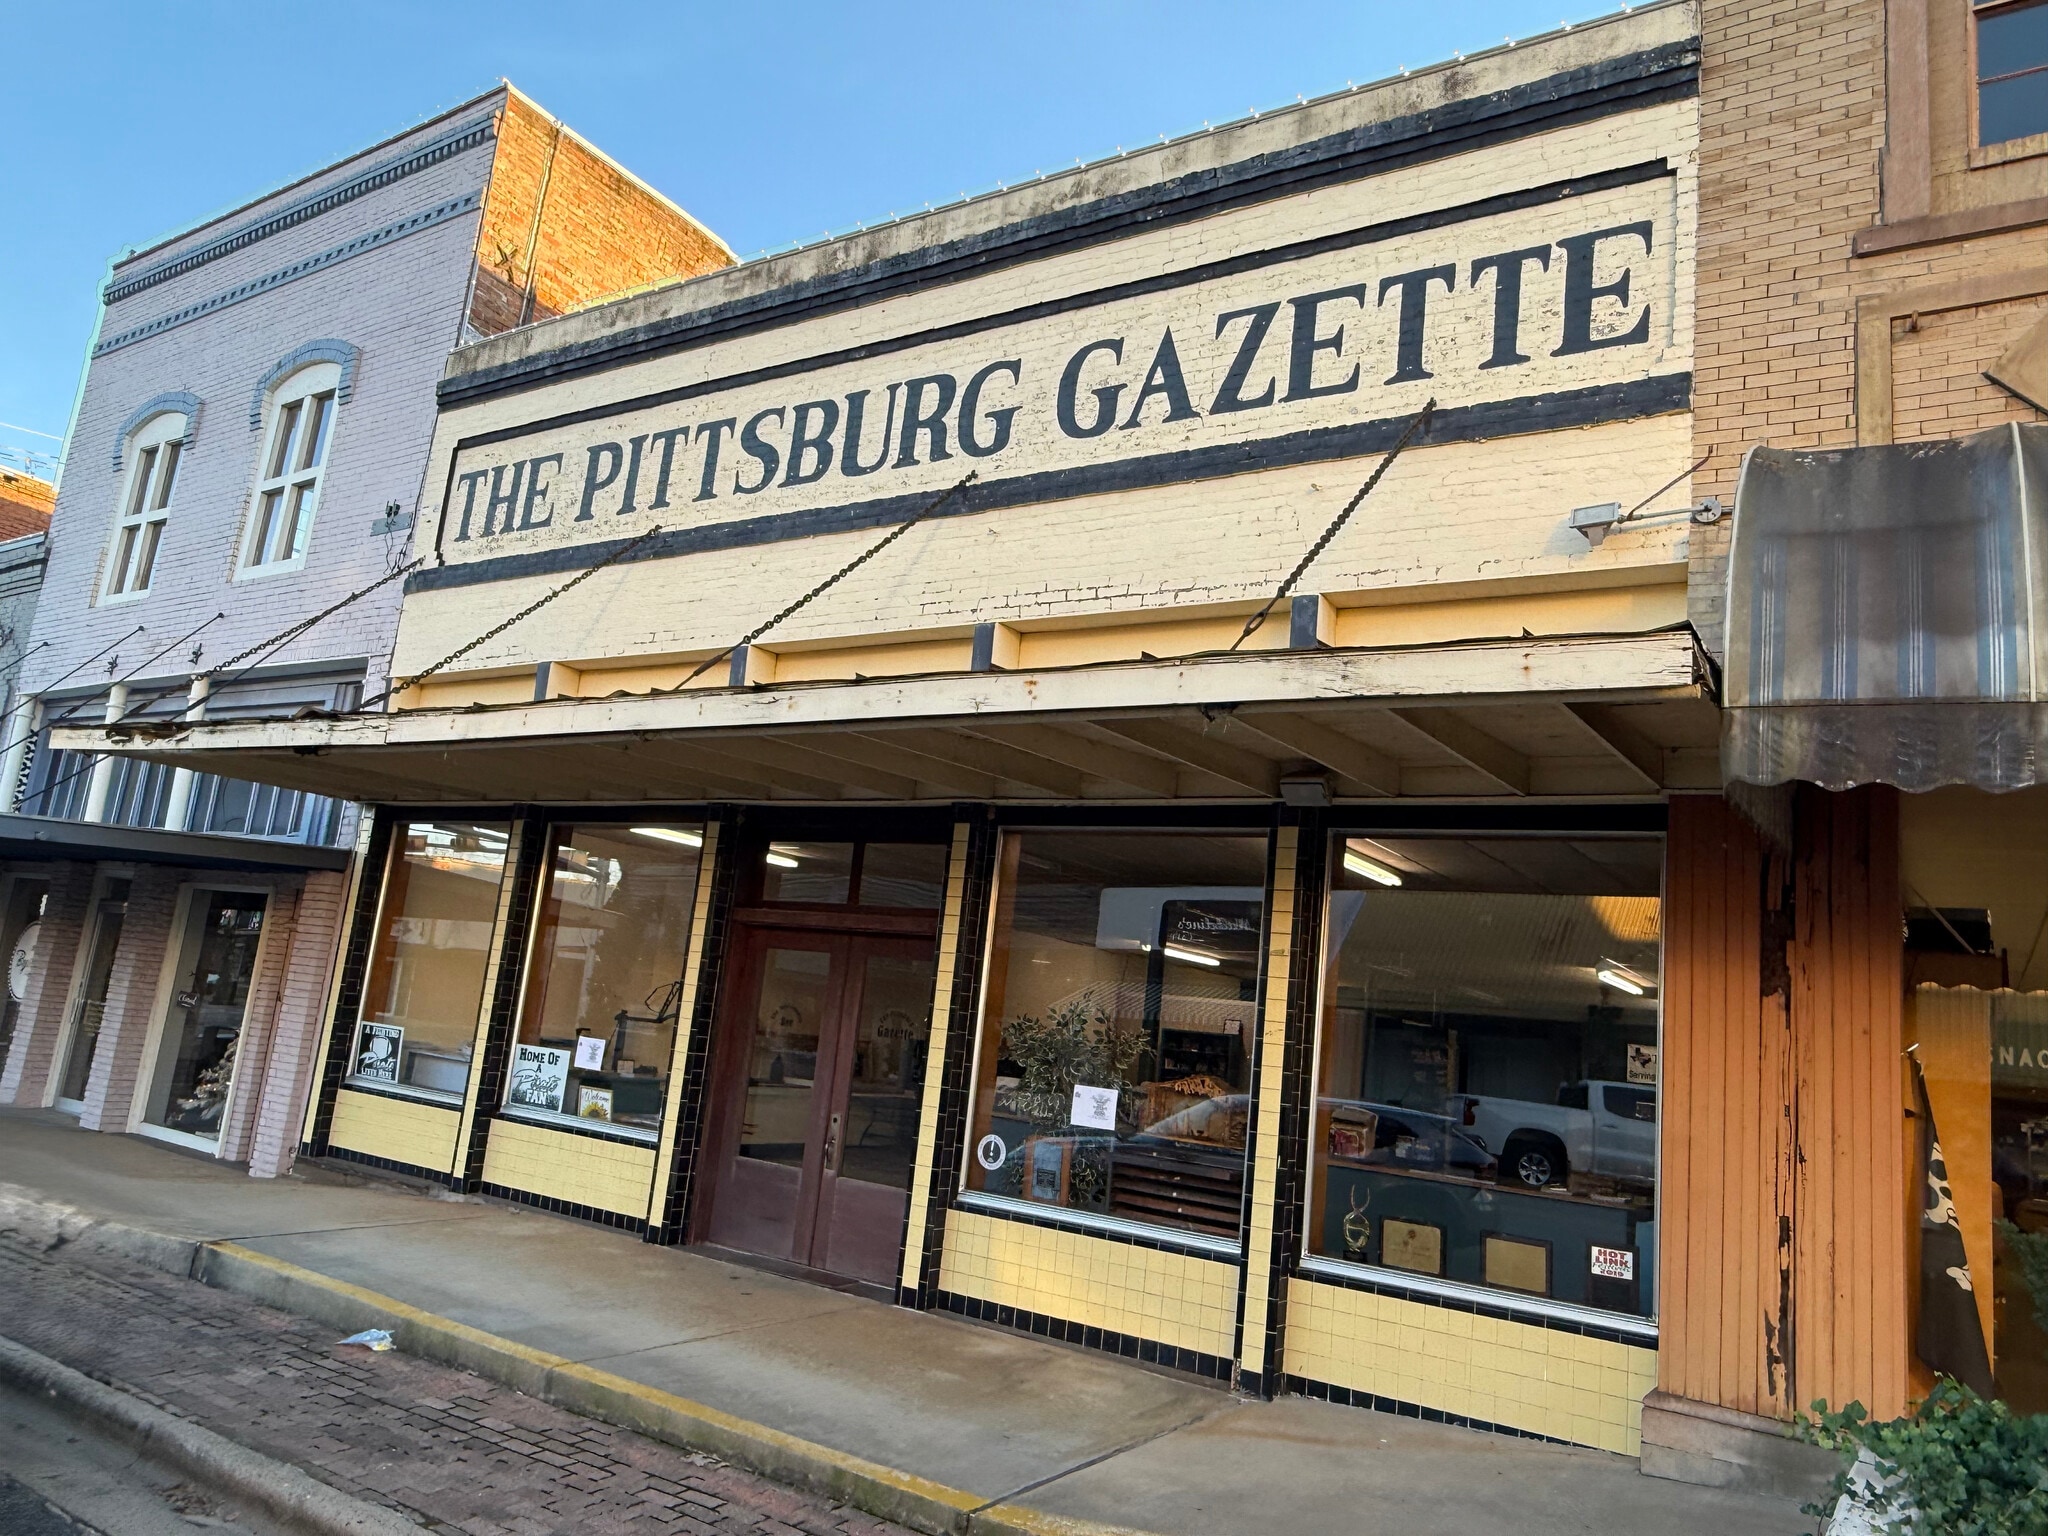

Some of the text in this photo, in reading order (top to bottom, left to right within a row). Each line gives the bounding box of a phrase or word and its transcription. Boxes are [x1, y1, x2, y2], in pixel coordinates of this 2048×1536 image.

[456, 219, 1654, 543] THE PITTSBURG GAZETTE
[535, 1064, 542, 1073] A
[525, 1089, 548, 1106] FAN
[1598, 1249, 1627, 1260] HOT
[1595, 1255, 1629, 1268] LINK
